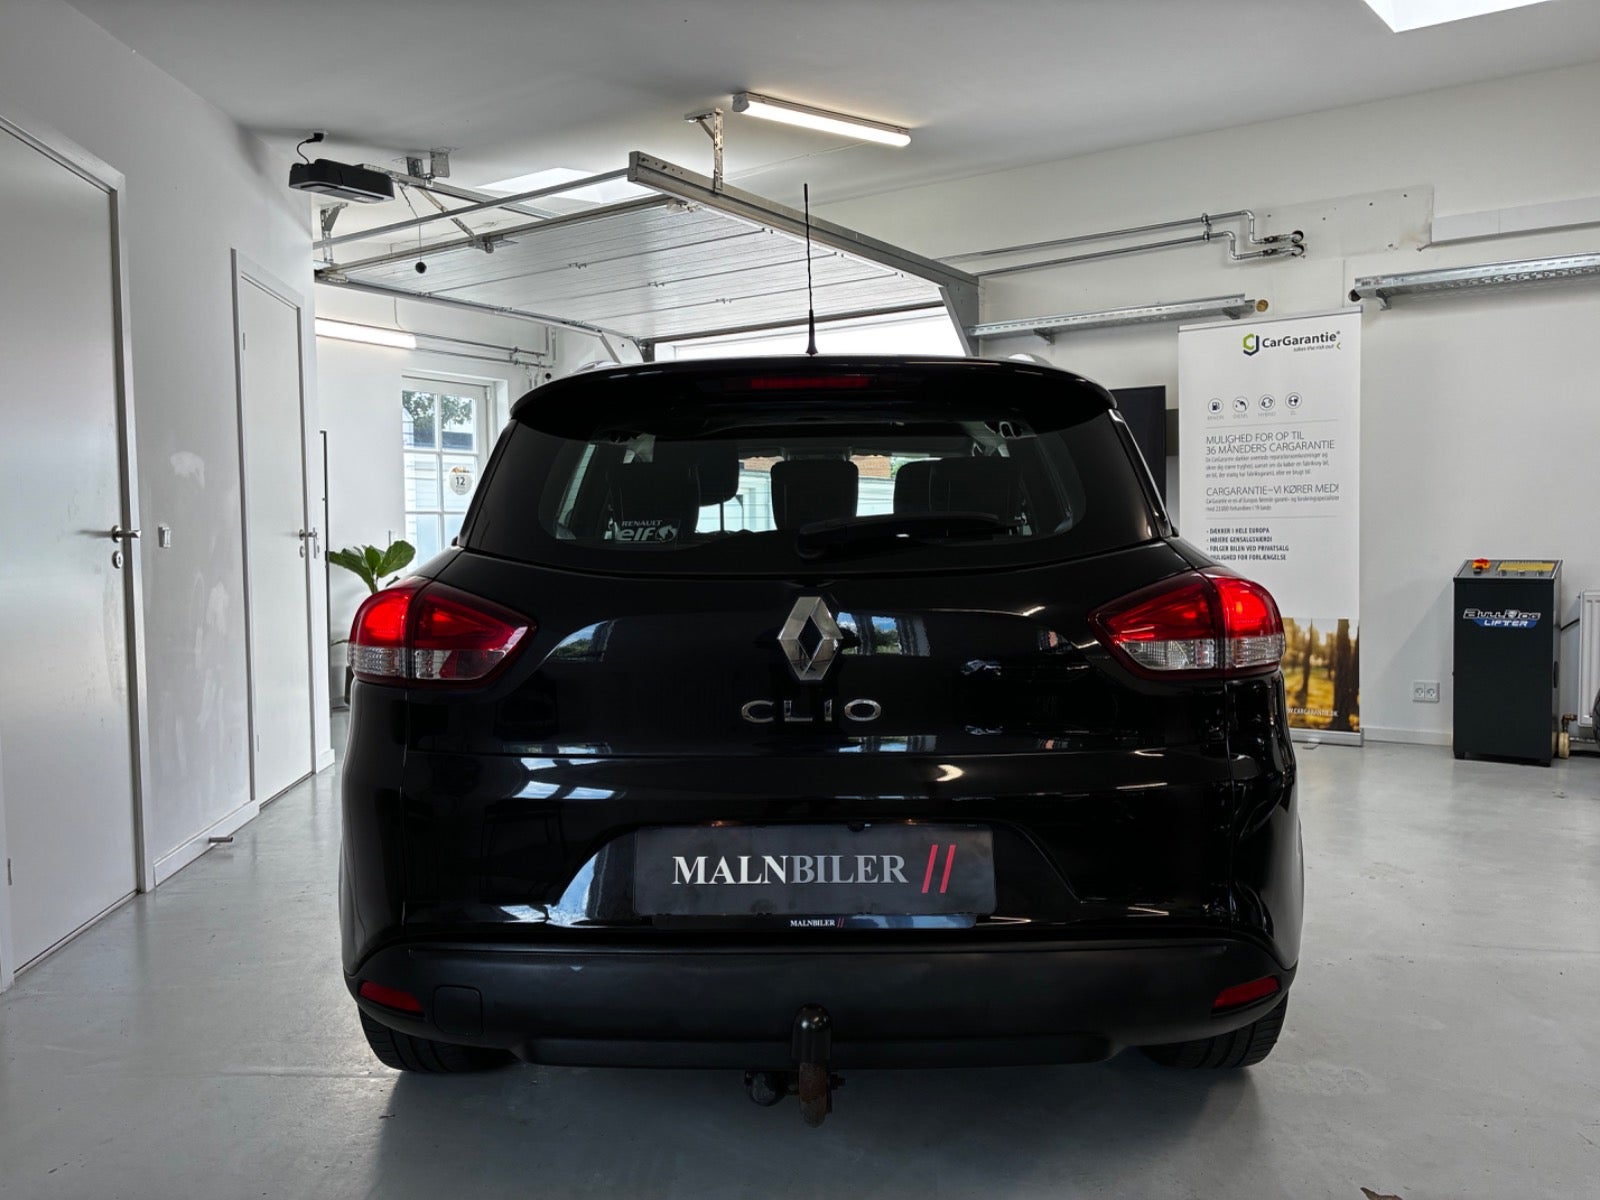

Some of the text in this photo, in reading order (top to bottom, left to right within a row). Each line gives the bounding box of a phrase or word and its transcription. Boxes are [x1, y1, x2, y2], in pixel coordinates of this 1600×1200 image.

[1206, 430, 1304, 445] MULIGHED FOR OP TIL
[1206, 439, 1335, 455] 36 MÅNEDERS CARGARANTIE
[455, 476, 466, 486] 12
[1283, 483, 1313, 495] KØRER
[1314, 483, 1340, 493] MED!
[619, 527, 657, 541] elf
[1484, 619, 1529, 627] LIFTER
[741, 699, 882, 724] CLIO
[671, 855, 909, 885] MALNBILER
[790, 918, 836, 927] MALNBILER
